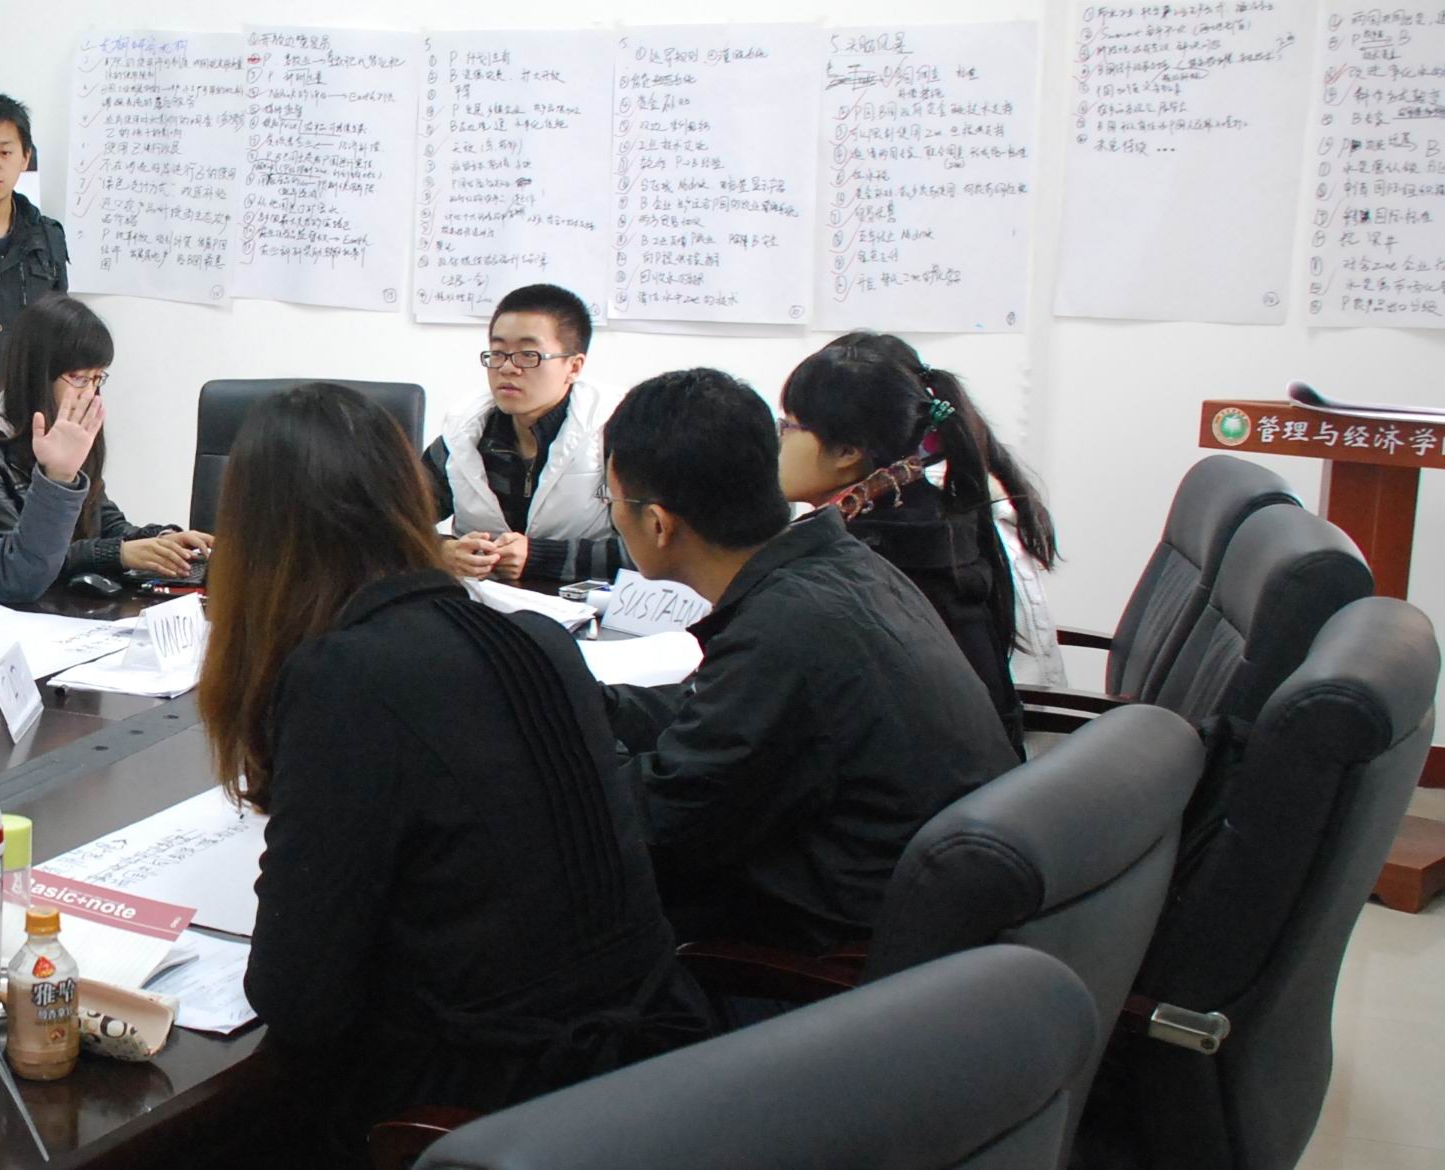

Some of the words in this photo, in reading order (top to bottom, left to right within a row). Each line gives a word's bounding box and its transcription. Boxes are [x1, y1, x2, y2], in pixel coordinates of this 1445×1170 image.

[1257, 416, 1445, 456] 管理与经济学
[613, 582, 704, 626] SUSTAIN
[31, 877, 137, 920] asic+note
